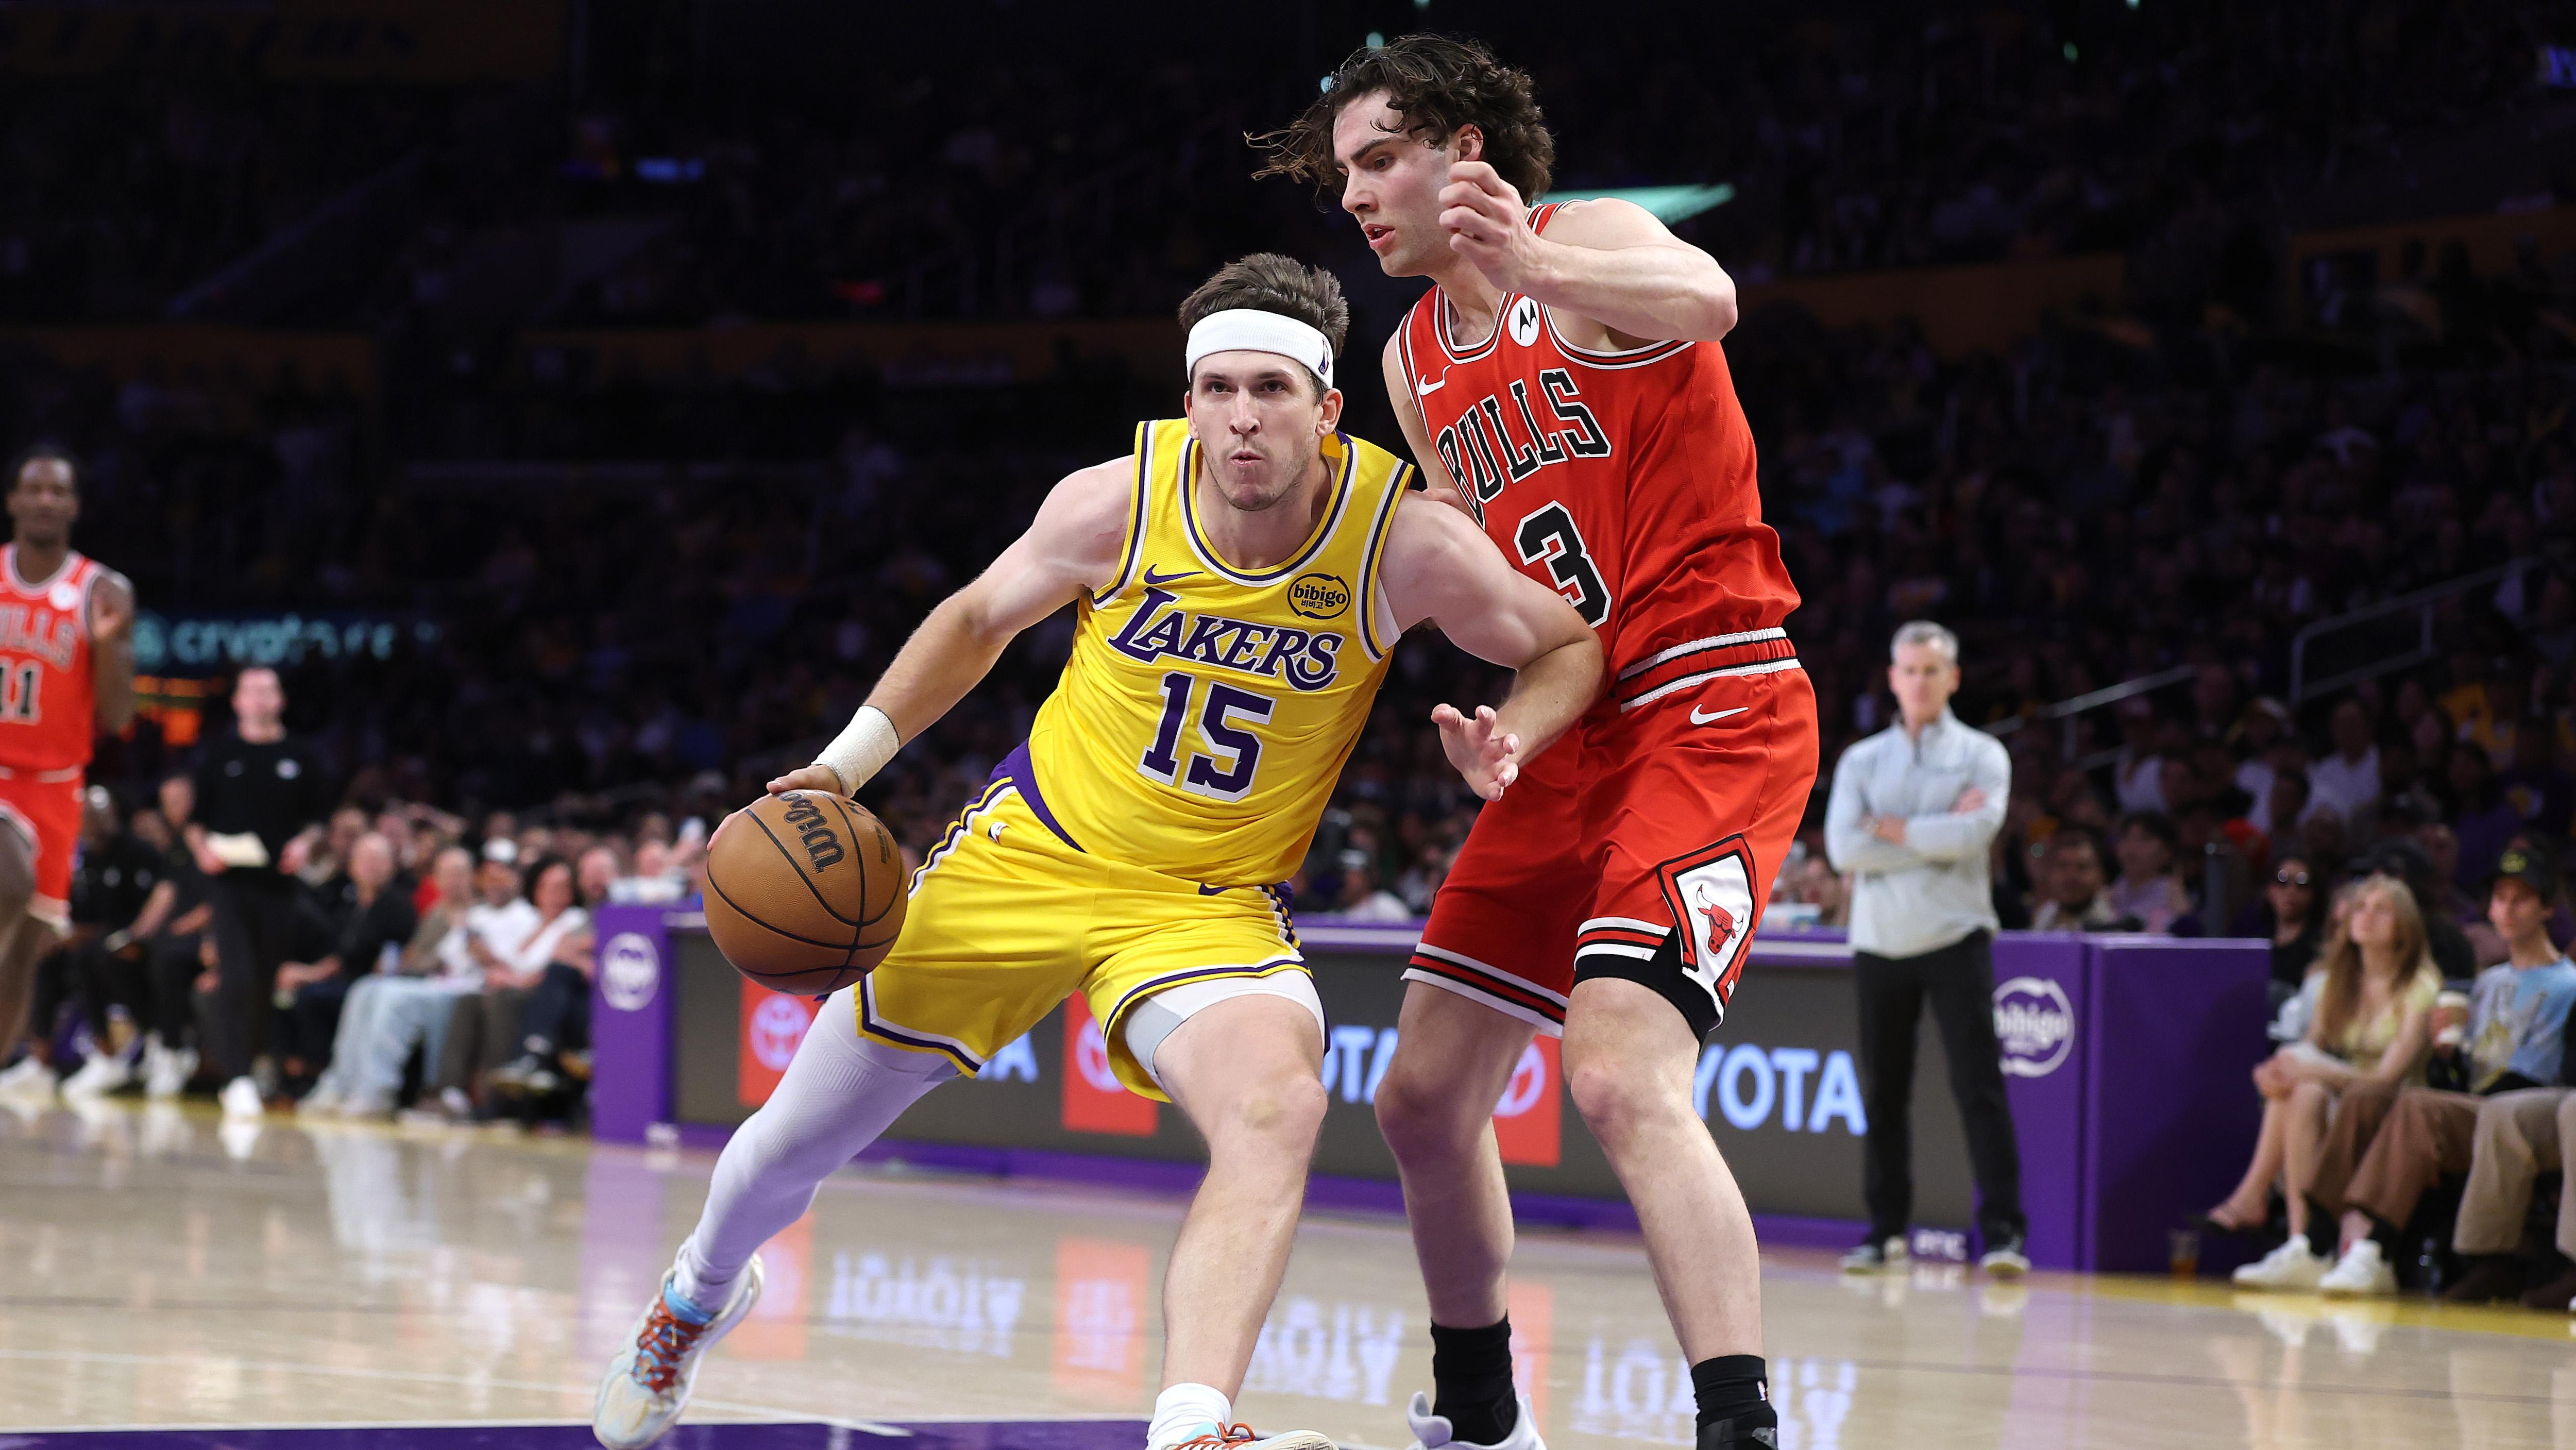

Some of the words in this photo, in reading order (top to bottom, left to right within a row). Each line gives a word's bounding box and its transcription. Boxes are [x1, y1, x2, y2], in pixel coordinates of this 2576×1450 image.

[1436, 368, 1612, 530] BULLS
[1294, 584, 1347, 608] bibigo
[1301, 599, 1324, 610] 비비고
[1514, 500, 1612, 629] 3
[1107, 586, 1346, 692] LAKERS
[1137, 670, 1277, 803] 15
[774, 793, 845, 873] Wilso
[1692, 1042, 1869, 1136] YOTA
